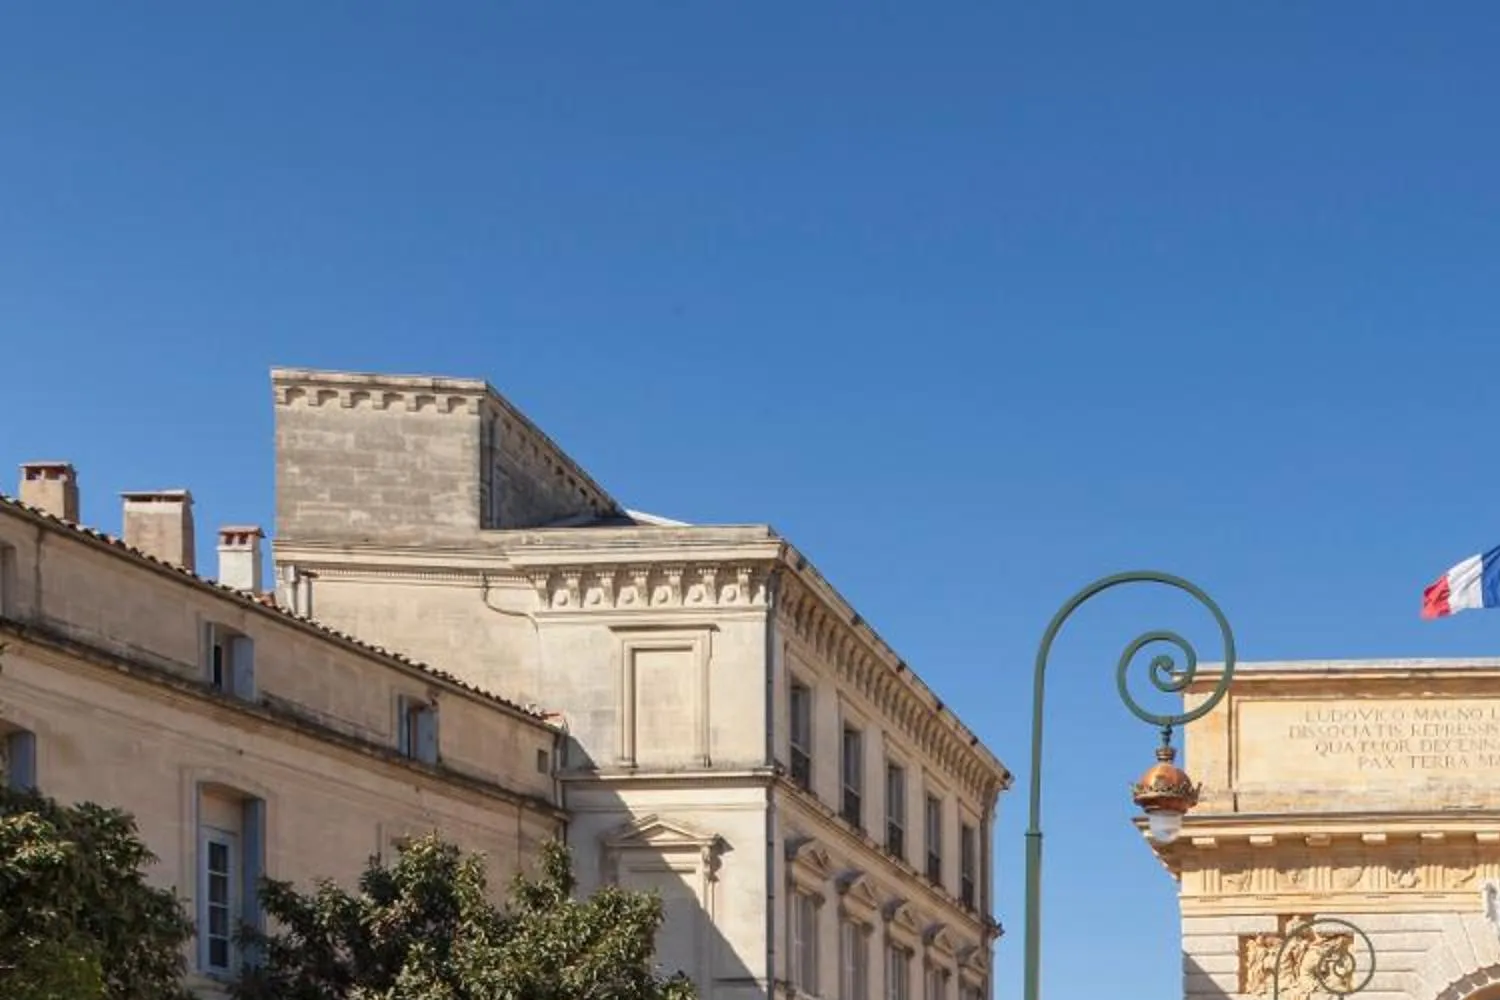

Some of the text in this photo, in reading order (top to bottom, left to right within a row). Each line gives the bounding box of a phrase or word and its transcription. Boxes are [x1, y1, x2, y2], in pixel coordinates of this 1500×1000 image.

[1305, 706, 1405, 721] LUDOVICO
[1414, 706, 1483, 720] MAGNO
[1288, 723, 1403, 739] DISSOCIATIS
[1314, 739, 1412, 757] QUATUOR
[1358, 755, 1396, 770] PAX
[1408, 755, 1470, 769] TERRA
